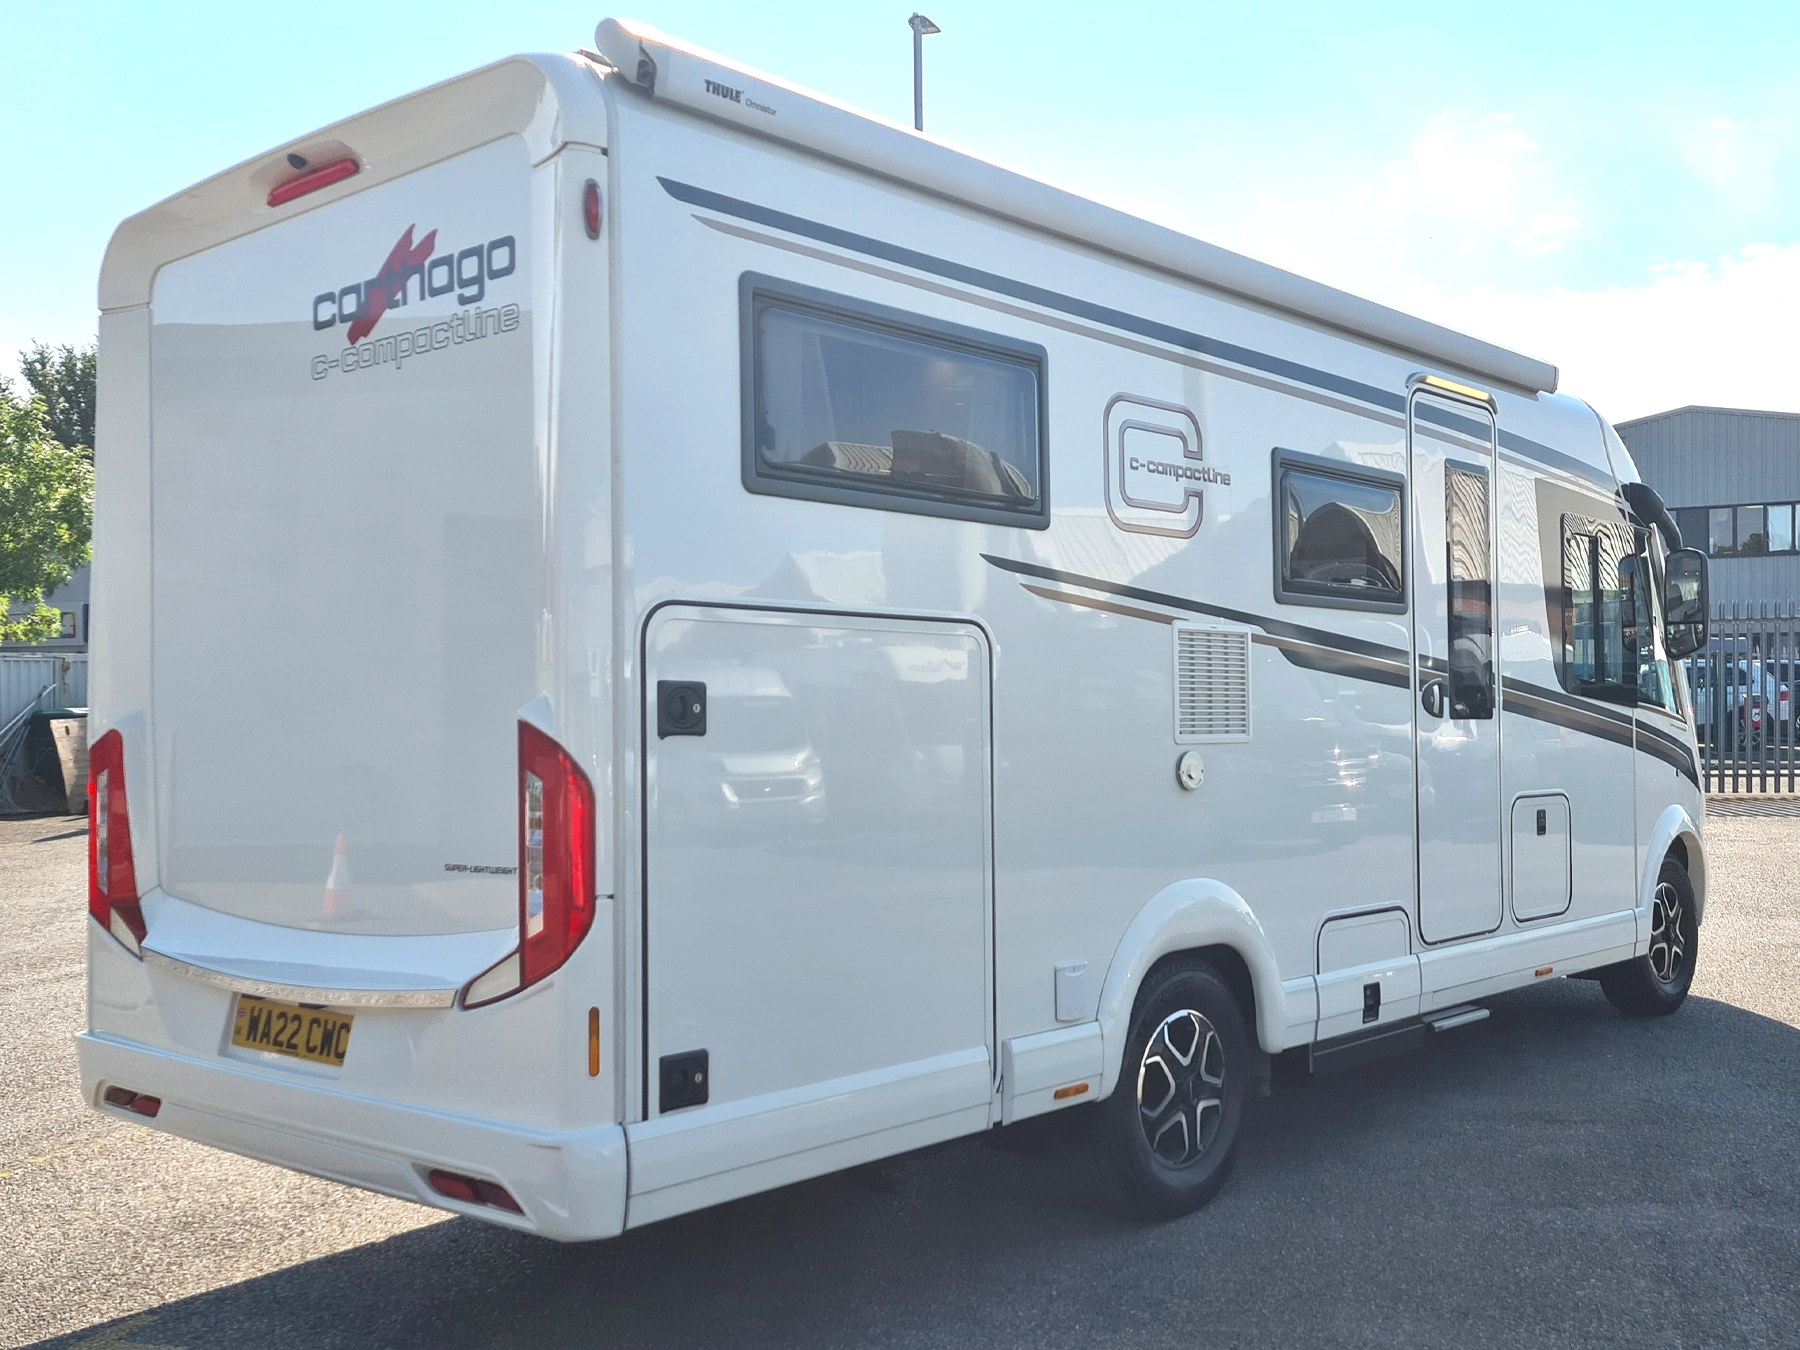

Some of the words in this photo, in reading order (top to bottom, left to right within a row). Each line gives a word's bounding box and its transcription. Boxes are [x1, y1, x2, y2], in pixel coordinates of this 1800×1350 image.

[704, 79, 741, 104] THULE
[313, 235, 516, 331] carthago
[311, 303, 520, 381] c-compactline
[1129, 457, 1231, 486] c-compactline
[245, 1006, 303, 1051] WA22
[305, 1017, 350, 1060] CWC
